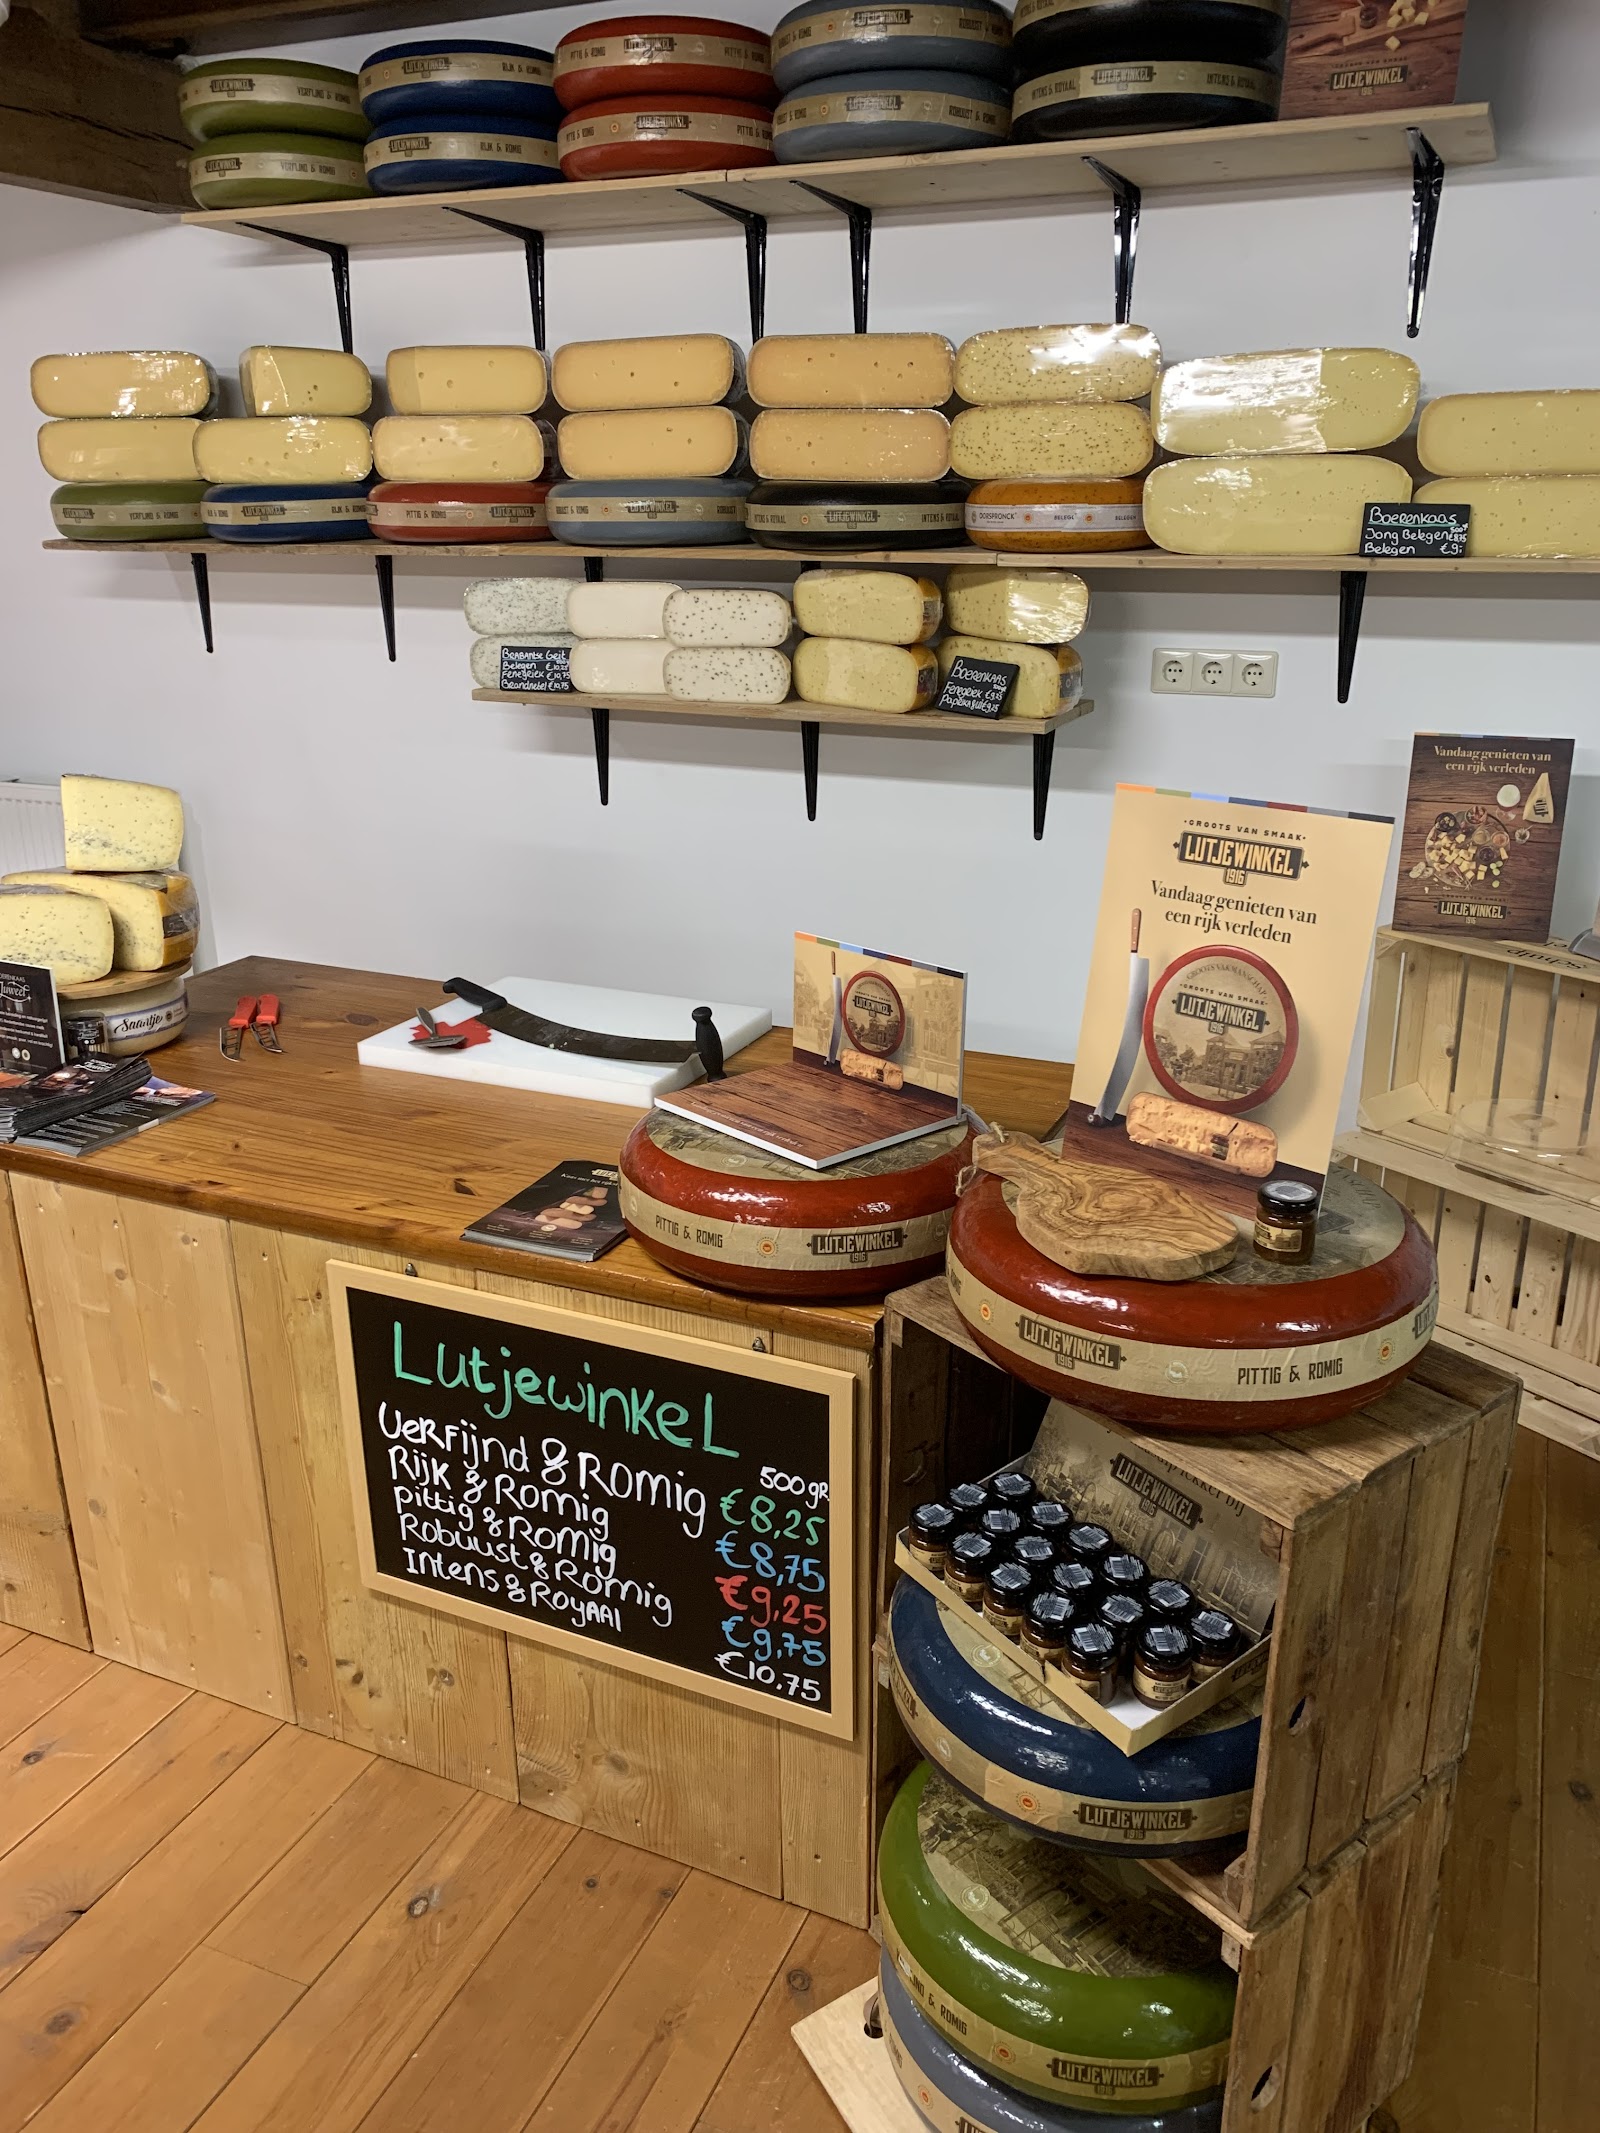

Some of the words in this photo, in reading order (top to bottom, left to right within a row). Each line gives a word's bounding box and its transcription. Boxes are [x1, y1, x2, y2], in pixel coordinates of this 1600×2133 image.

[1095, 69, 1150, 84] LUTJEWINKEL
[1333, 68, 1404, 90] LUTJEWINKEL
[1364, 542, 1416, 557] Belegen
[1365, 528, 1399, 546] Jong
[1402, 528, 1449, 545] Belegen
[1434, 745, 1482, 762] Vandaag
[1480, 749, 1530, 762] genieten
[1531, 753, 1552, 762] van
[1445, 761, 1465, 772] een
[1466, 762, 1487, 775] rijk
[1488, 762, 1536, 775] verleden
[1189, 819, 1231, 831] GROOTS
[1236, 825, 1258, 835] VAN
[1263, 829, 1303, 841] SMAAK
[1184, 835, 1294, 876] LUTJEWINKEL
[1226, 868, 1246, 885] 1916
[1150, 879, 1215, 911] Vandaag
[1214, 895, 1285, 919] genieten
[1288, 908, 1317, 925] van
[1441, 901, 1504, 919] LUTJEWINKEL
[1165, 909, 1191, 926] een
[1193, 911, 1221, 934] rijk
[1224, 920, 1292, 944] verleden
[1183, 983, 1215, 995] GROOTS
[1218, 991, 1234, 999] VAN
[1180, 995, 1260, 1031] LUTJEWINKEL
[656, 1214, 679, 1237] PITTIG
[683, 1225, 691, 1240] &
[696, 1230, 723, 1249] ROMIG
[817, 1230, 900, 1255] LUTJEWINKEL
[851, 1251, 868, 1263] 1916
[1023, 1319, 1114, 1368] LUTJEWINKEL
[1056, 1354, 1073, 1368] 1916
[1237, 1366, 1281, 1385] PITTIG
[1289, 1365, 1301, 1383] &
[1308, 1358, 1343, 1381] ROMIG
[541, 1437, 570, 1486] &
[577, 1451, 707, 1539] Romig
[1115, 1457, 1194, 1526] LUTJEWINKEL
[494, 1473, 609, 1542] Romig
[714, 1530, 826, 1593] €8,75
[393, 1485, 474, 1532] Pittig
[508, 1515, 617, 1580] Romig
[714, 1574, 828, 1635] €9,25
[399, 1512, 529, 1571] Robuust
[555, 1558, 673, 1628] Romig
[402, 1546, 500, 1593] Intens
[1084, 1805, 1186, 1830] LUTJEWINKEL
[1126, 1829, 1145, 1839] 1916
[928, 1993, 937, 2010] &
[940, 2003, 968, 2035] ROMIG
[1058, 2059, 1154, 2085] LUTJEWINKEL
